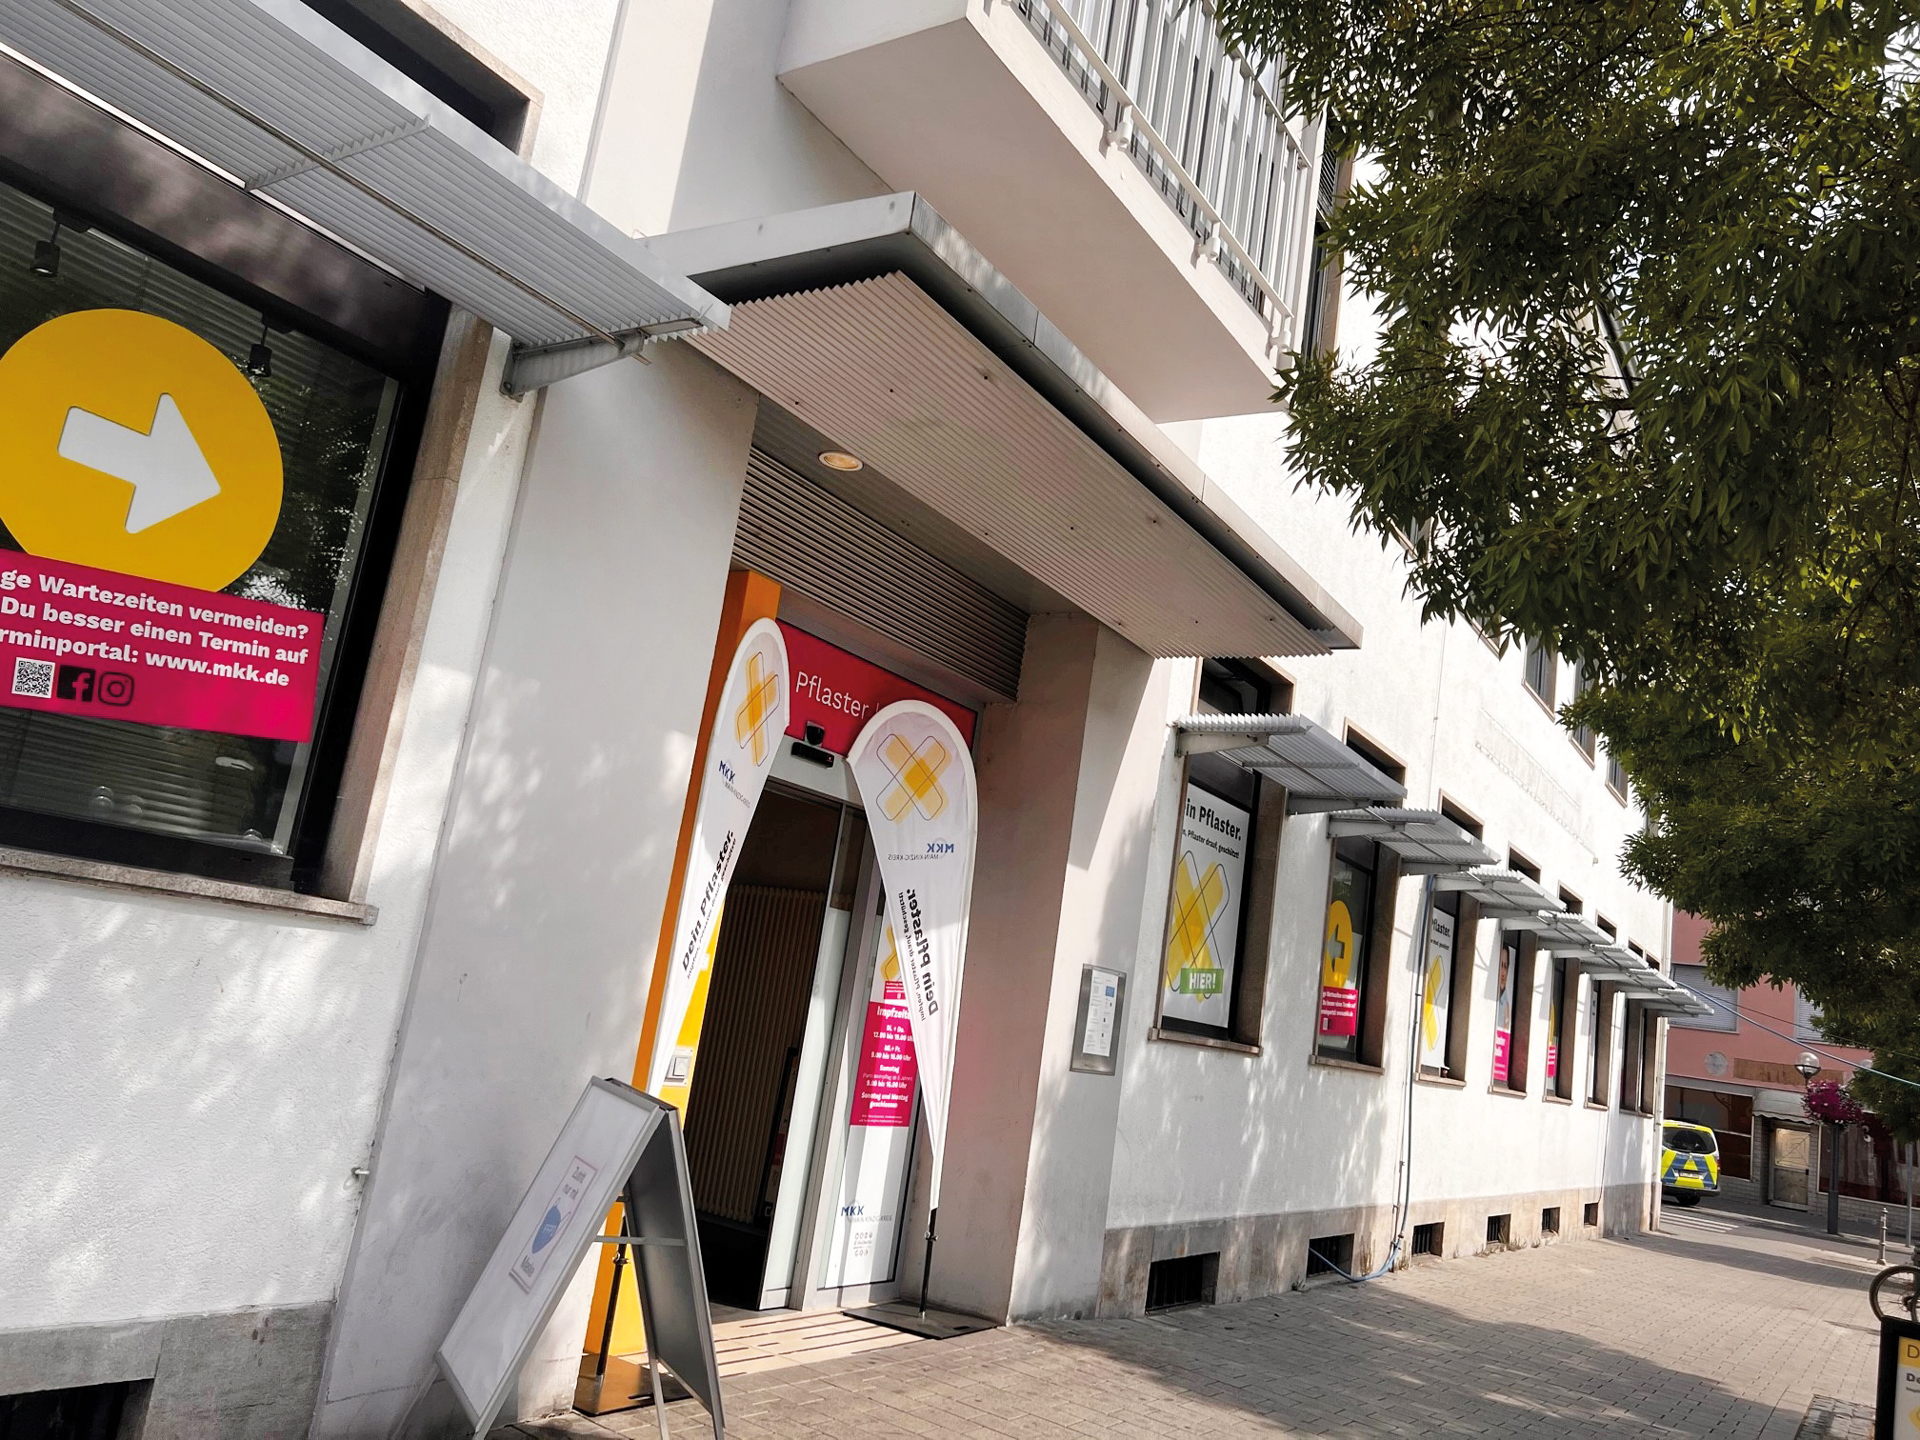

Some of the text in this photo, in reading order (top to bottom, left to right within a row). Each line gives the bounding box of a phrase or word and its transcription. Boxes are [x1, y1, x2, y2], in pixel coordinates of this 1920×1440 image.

[39, 574, 184, 617] Wartezeiten
[189, 606, 309, 640] vermeiden?
[1, 596, 309, 664] Du besser einen Termin auf
[145, 652, 290, 686] www.mkk.de
[796, 671, 869, 720] Pflaster
[1187, 829, 1206, 844] Pflaster
[1199, 806, 1242, 841] Pflaster.
[682, 830, 734, 971] Dein Pflaster.
[1189, 972, 1217, 989] HIER!
[840, 1205, 865, 1217] MKK
